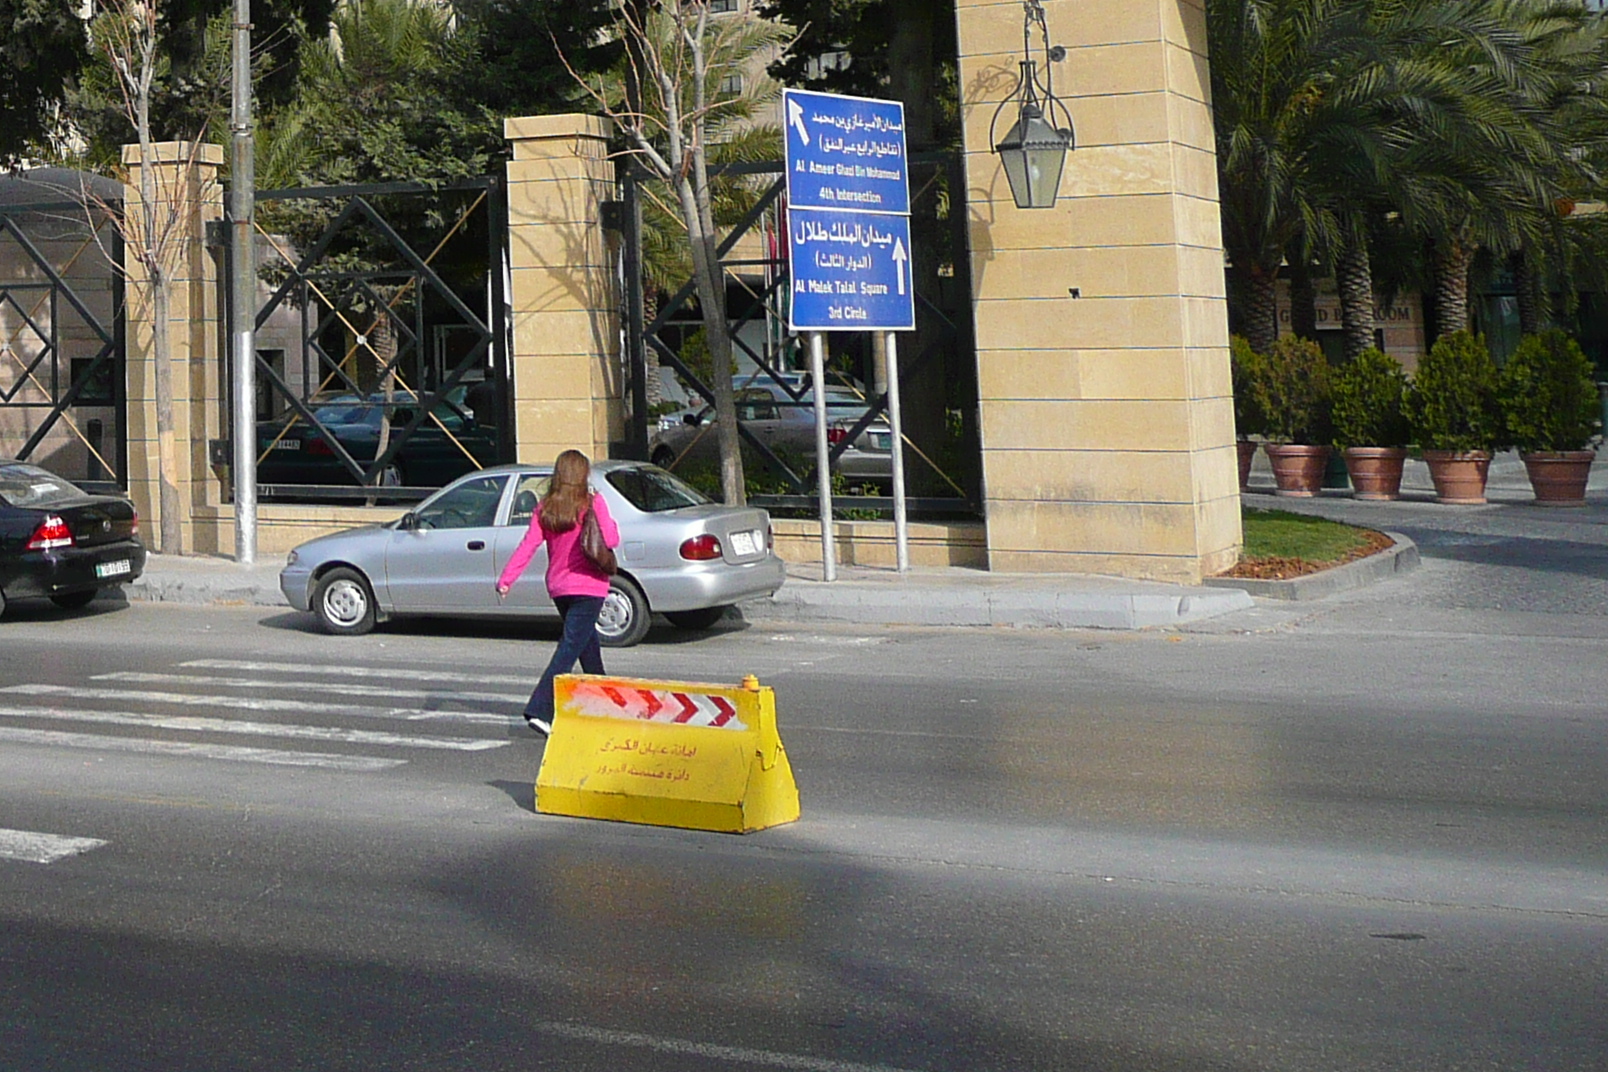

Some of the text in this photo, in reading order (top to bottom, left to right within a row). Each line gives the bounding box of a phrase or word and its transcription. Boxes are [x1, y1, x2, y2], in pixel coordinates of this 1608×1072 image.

[812, 112, 835, 124] محمد
[796, 159, 805, 172] Al
[819, 186, 882, 203] 4th Intersection
[795, 220, 828, 245] طلال
[861, 224, 892, 249] ميدان
[795, 279, 888, 297] Al Malek Talal Square
[828, 306, 867, 319] 3rd Circle
